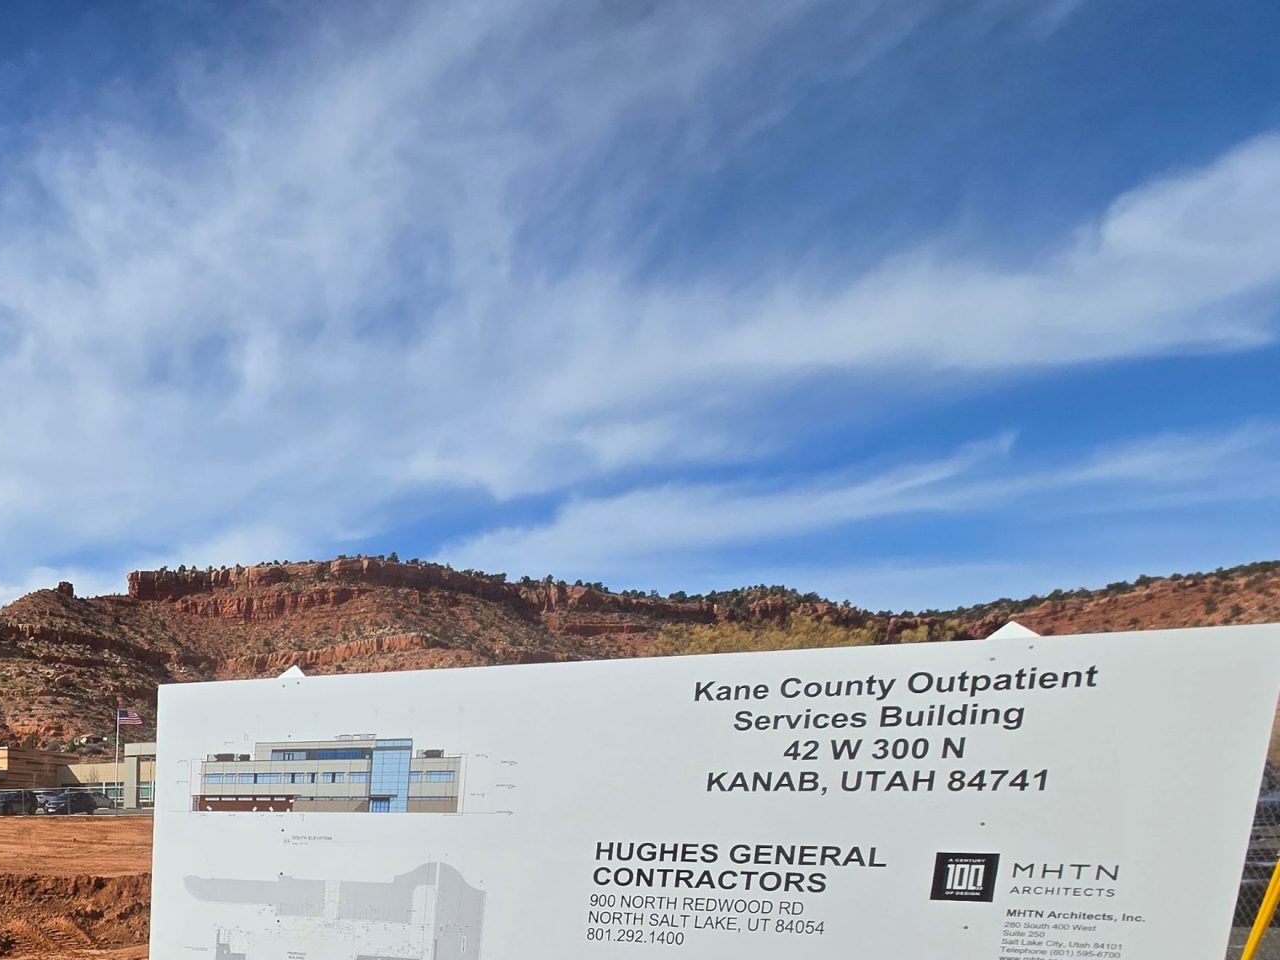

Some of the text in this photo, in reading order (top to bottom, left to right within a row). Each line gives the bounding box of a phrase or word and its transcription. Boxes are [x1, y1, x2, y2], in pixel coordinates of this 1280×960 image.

[694, 665, 1099, 702] Kane County Outpatient
[733, 705, 1024, 731] Services Building
[784, 737, 966, 760] 42 W 300 N
[706, 769, 1049, 796] KANAB, UTAH 84741
[595, 842, 887, 867] HUGHES GENERAL
[593, 867, 827, 893] CONTRACTORS
[946, 864, 985, 890] 100
[1012, 863, 1120, 881] MHTN
[1009, 886, 1116, 897] ARCHITECTS
[590, 894, 804, 915] 900 NORTH REDWOOD RD
[1006, 909, 1146, 922] MHTN Architects, Inc.
[588, 911, 825, 934] NORTH SALT LAKE, UT 84054
[1004, 921, 1021, 929] 280
[586, 928, 684, 945] 801.292.1400
[1021, 939, 1043, 947] Lake
[1046, 940, 1066, 948] City,
[1069, 941, 1091, 949] Utah
[1000, 947, 1121, 959] Telephone (801) 595-6700
